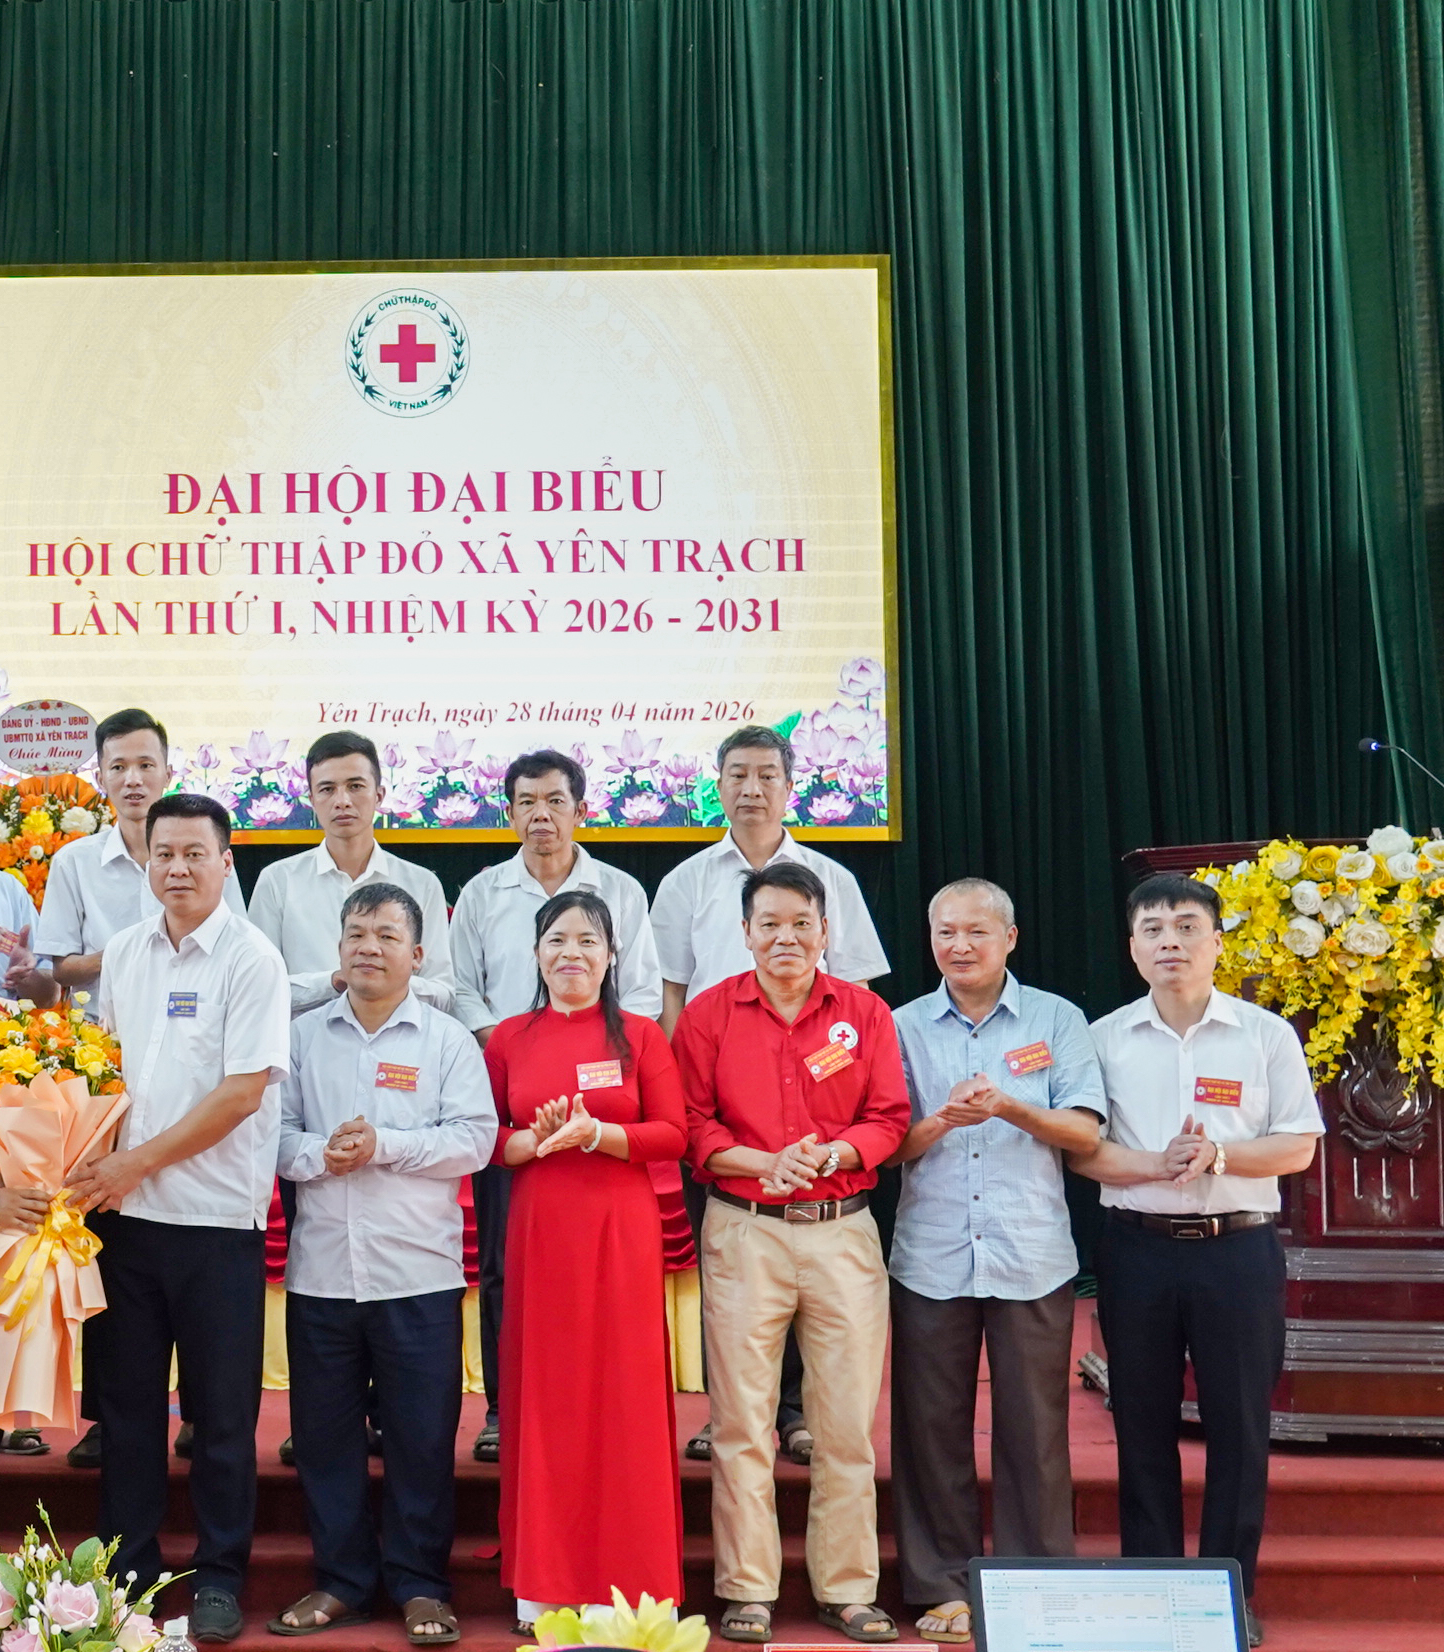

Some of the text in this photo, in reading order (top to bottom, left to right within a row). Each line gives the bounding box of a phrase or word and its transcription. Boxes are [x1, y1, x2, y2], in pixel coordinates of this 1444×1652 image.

[389, 399, 429, 412] VIỆT NAM
[162, 456, 665, 526] ĐẠI HỘI ĐẠI BIỂU
[26, 528, 807, 585] HỘI CHỮ THẬP ĐỎ XÃ YÊN TRẠCH
[50, 591, 141, 635] LẦN
[155, 591, 258, 635] THỨ
[270, 601, 297, 641] I,
[310, 594, 468, 643] NHIỆM
[486, 589, 548, 633] KỲ
[564, 598, 654, 633] 2026
[695, 598, 783, 632] 2031
[68, 716, 89, 726] UBND
[317, 701, 755, 728] Yên Trạch, ngày 28 tháng 04 năm 2026
[3, 732, 34, 743] UBMTTQ
[47, 730, 62, 741] YÊN
[64, 730, 89, 743] TRẠCH
[8, 746, 83, 760] Chúc Mừng
